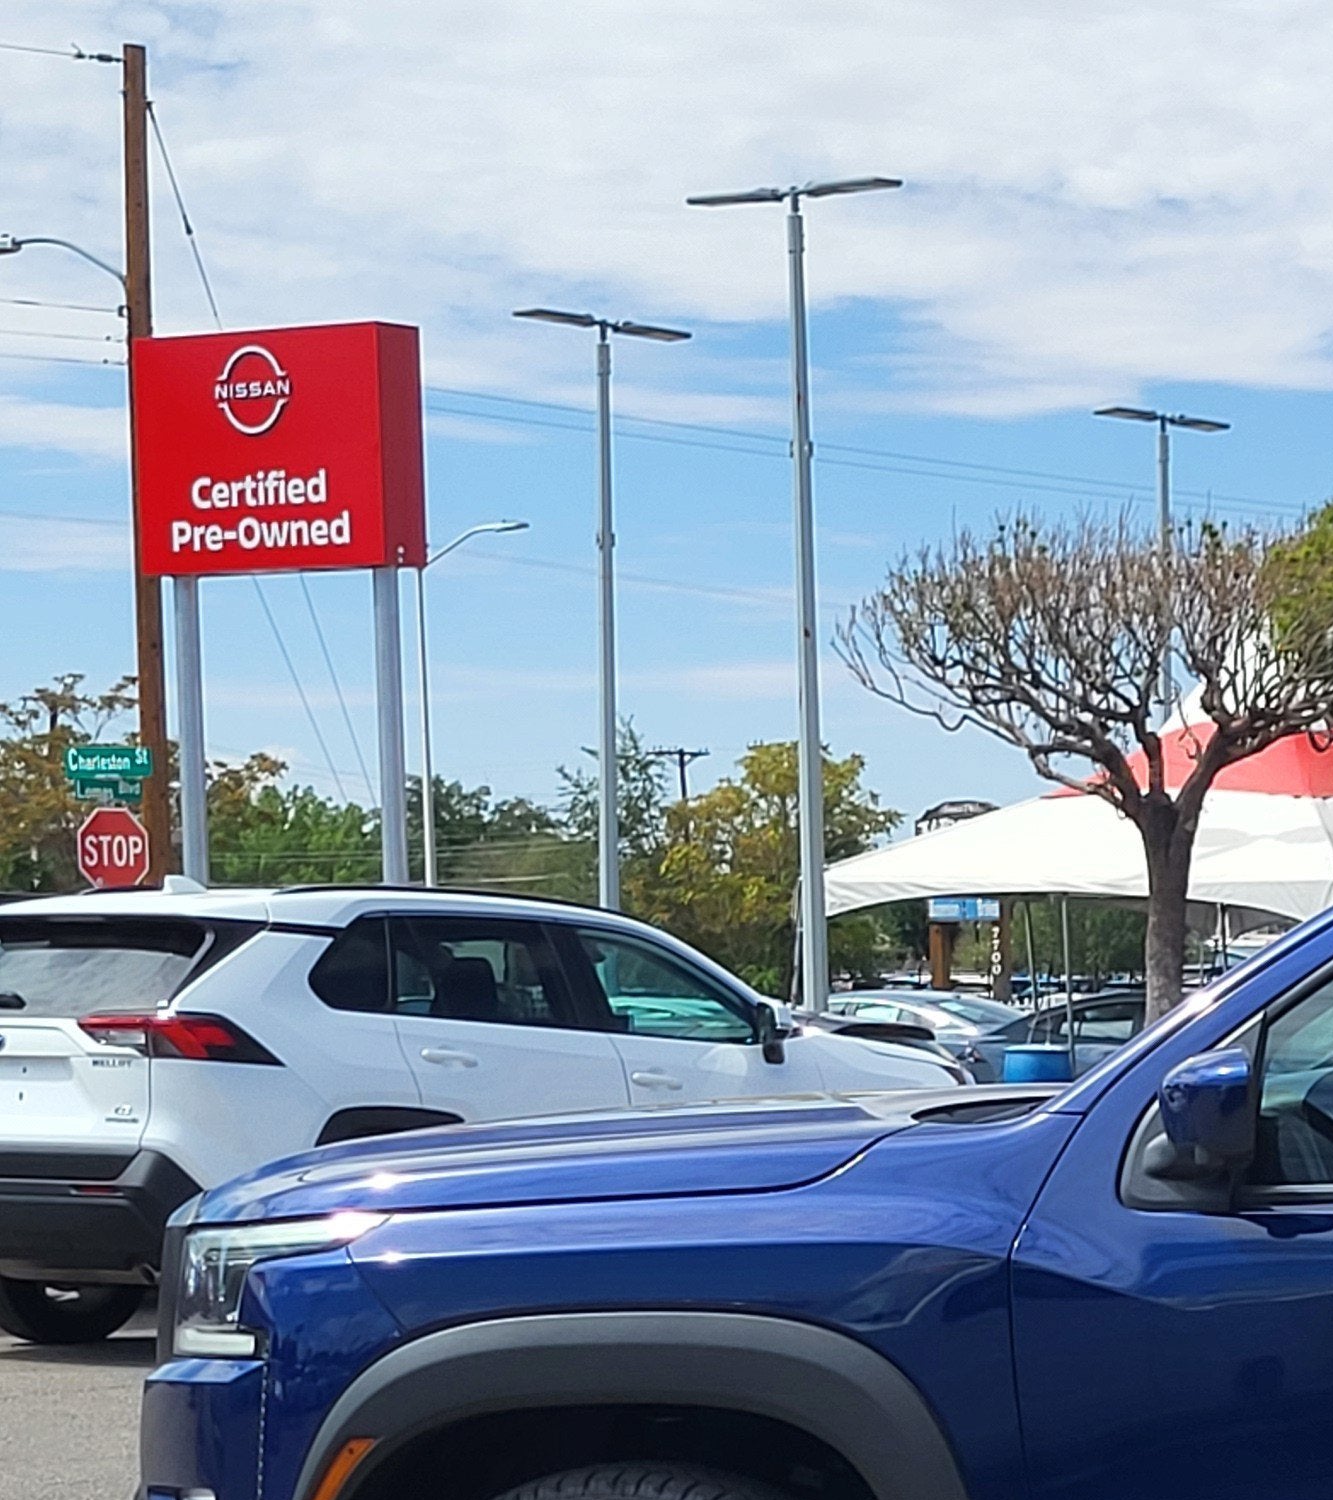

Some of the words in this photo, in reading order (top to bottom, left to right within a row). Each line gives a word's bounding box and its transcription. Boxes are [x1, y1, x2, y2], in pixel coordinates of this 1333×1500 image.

[214, 378, 290, 399] NISSAN
[191, 468, 327, 509] Certified
[171, 510, 351, 553] Pre-Owned
[68, 748, 131, 771] Charleston
[135, 747, 148, 765] St
[84, 834, 143, 867] STOP
